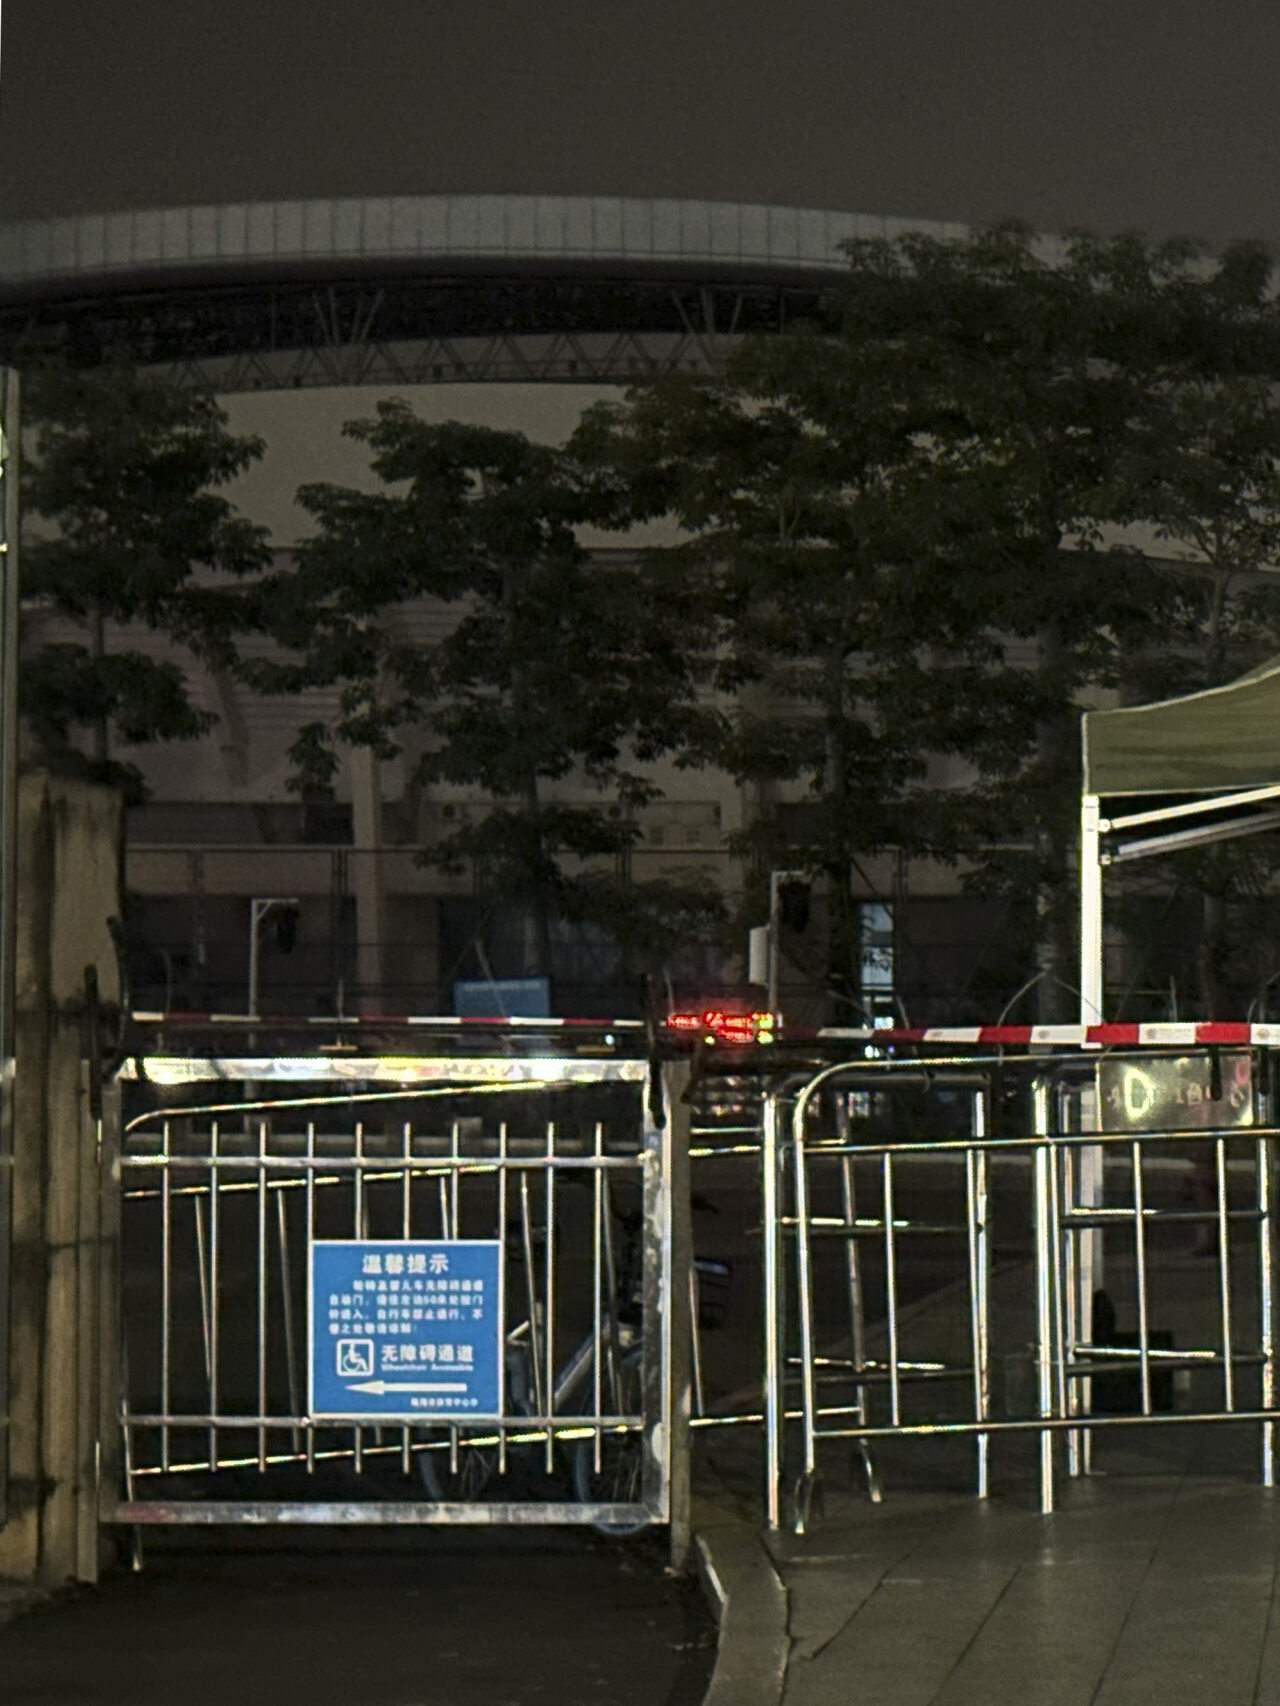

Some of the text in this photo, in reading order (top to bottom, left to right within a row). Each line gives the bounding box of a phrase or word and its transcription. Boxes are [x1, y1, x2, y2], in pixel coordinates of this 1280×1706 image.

[362, 1254, 449, 1274] 温馨提示
[381, 1344, 474, 1362] 无障碍通道
